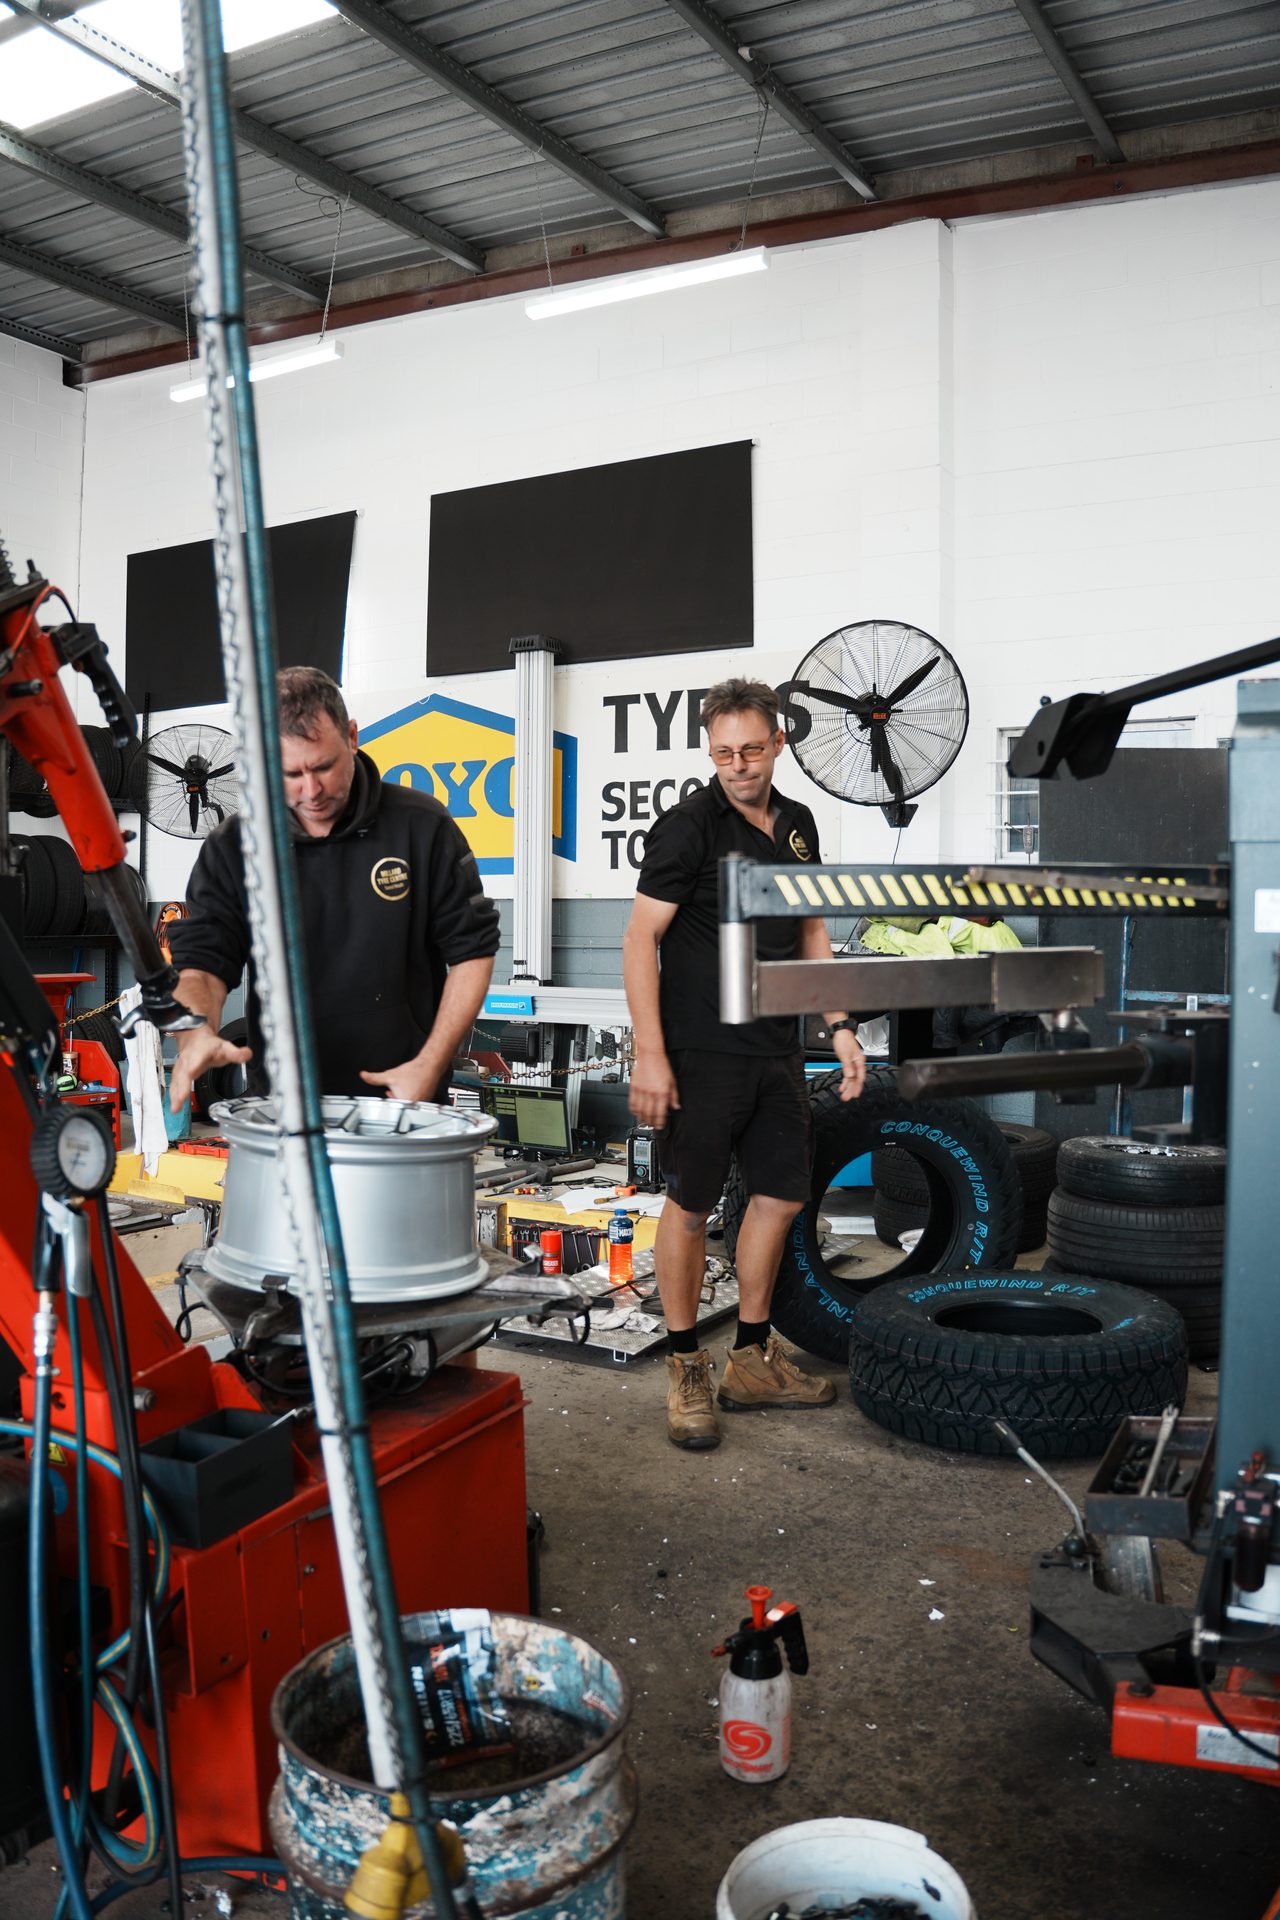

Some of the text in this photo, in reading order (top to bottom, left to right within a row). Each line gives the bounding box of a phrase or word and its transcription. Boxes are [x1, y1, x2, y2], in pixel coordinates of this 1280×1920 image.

[602, 679, 813, 754] TYS
[880, 1121, 989, 1265] CONQUEWIND R/T
[1050, 1282, 1096, 1297] R/T
